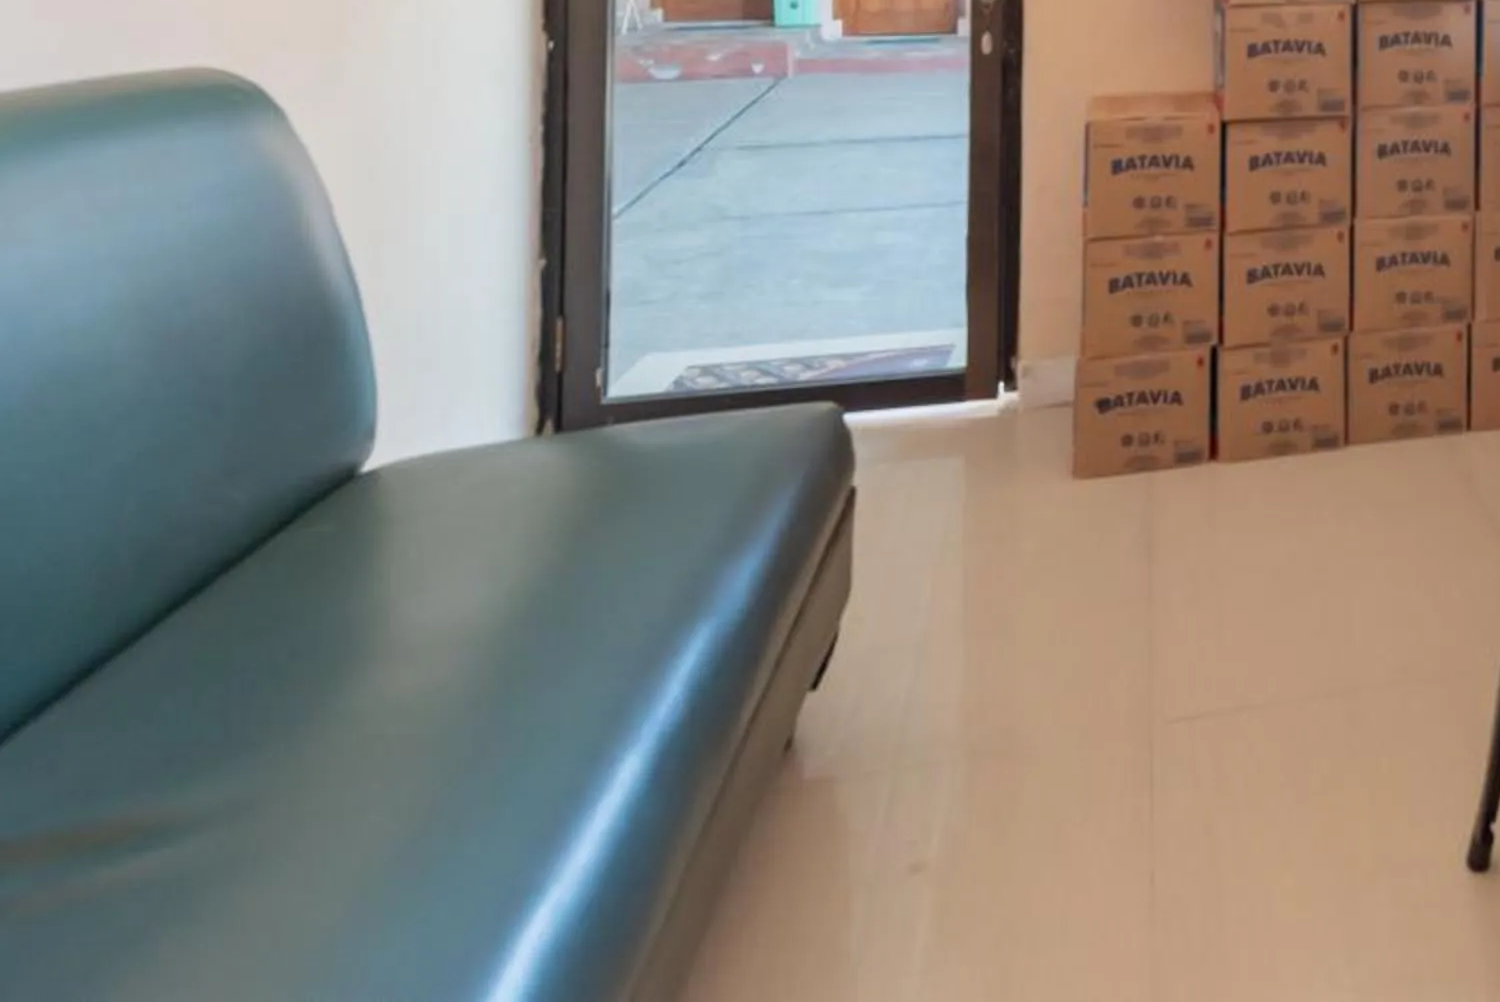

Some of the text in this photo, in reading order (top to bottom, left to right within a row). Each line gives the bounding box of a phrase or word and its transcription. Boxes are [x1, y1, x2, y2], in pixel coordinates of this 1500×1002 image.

[1247, 39, 1327, 59] BATAVIA
[1378, 30, 1453, 51] BATAVIA
[1377, 138, 1452, 160] BATAVIA
[1111, 153, 1195, 175] BATAVIA
[1249, 150, 1327, 172] BATAVIA
[1246, 261, 1326, 285] BATAVIA
[1375, 250, 1451, 273] BATAVIA
[1107, 270, 1194, 295] BATAVIA
[1368, 361, 1445, 385] BATAVIA
[1239, 376, 1321, 401] BATAVIA
[1094, 389, 1184, 415] BATAVIA
